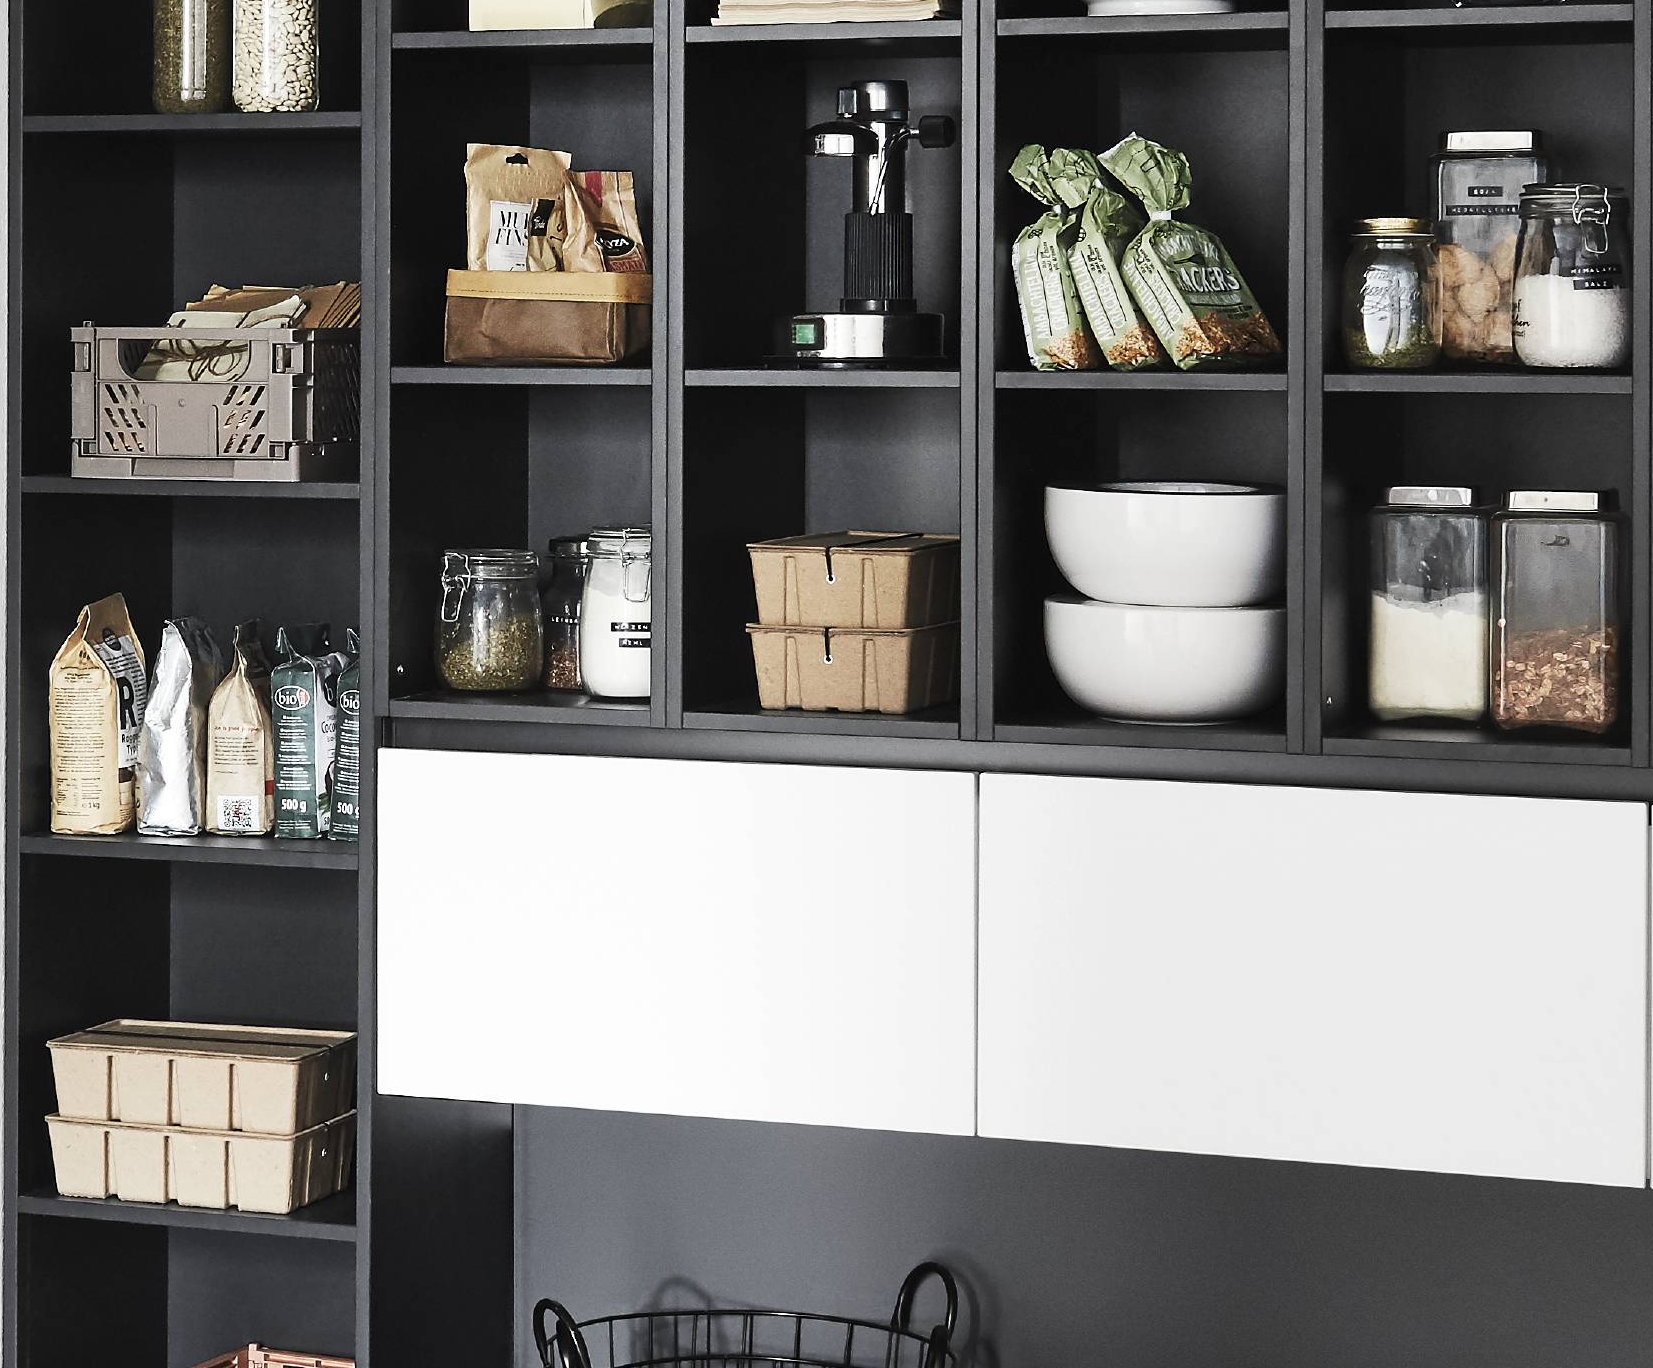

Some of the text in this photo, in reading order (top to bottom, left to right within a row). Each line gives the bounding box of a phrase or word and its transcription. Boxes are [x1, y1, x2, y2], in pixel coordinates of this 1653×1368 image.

[115, 677, 138, 730] R
[278, 691, 297, 705] bio
[343, 695, 360, 710] bio
[281, 798, 307, 813] 500 g
[337, 802, 353, 815] 500
